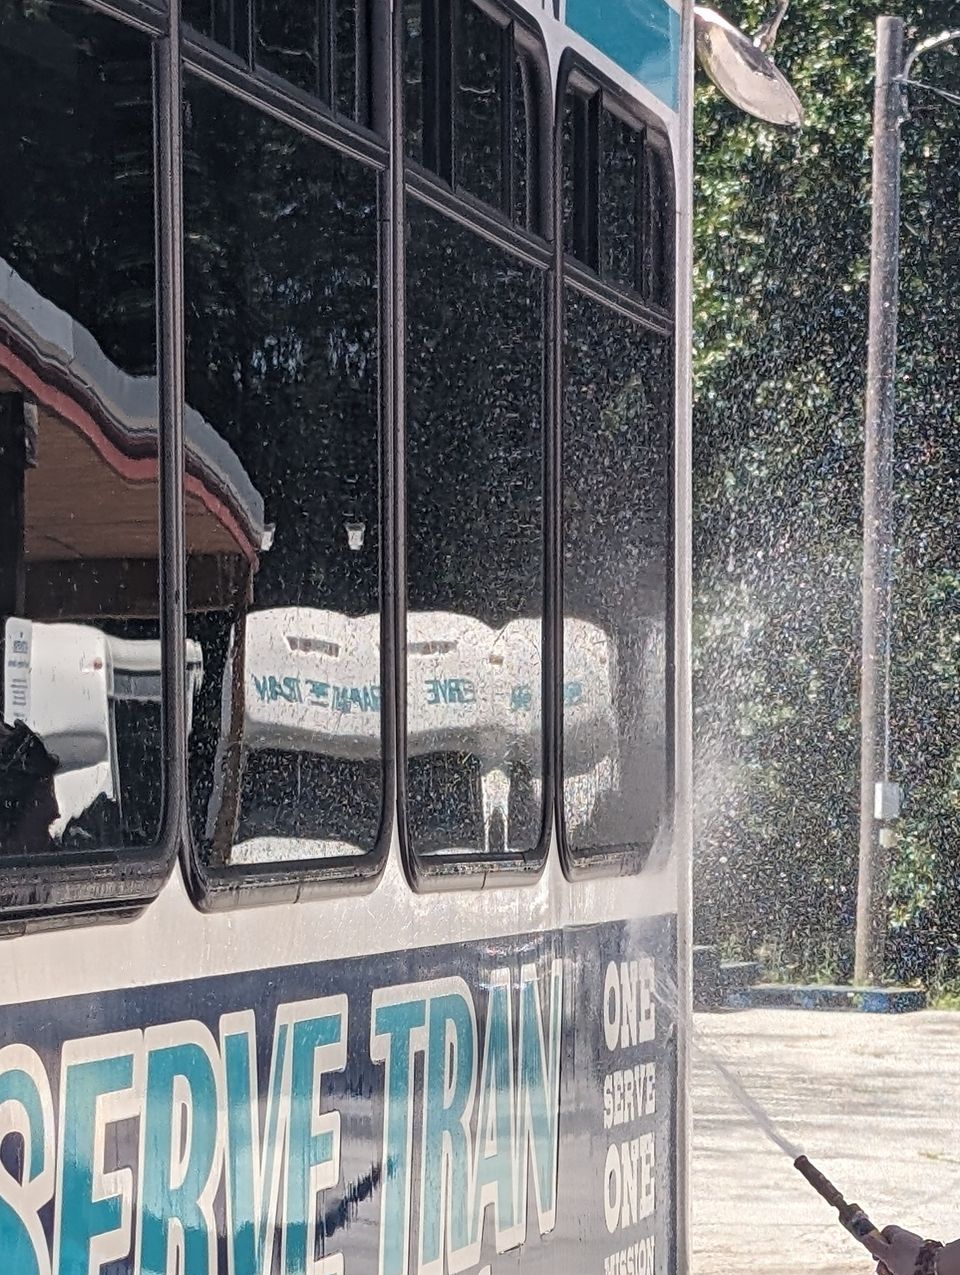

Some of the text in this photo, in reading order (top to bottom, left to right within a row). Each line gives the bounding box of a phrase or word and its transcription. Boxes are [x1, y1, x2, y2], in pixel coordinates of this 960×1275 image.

[603, 957, 656, 1051] ONE
[603, 1061, 657, 1130] SERVE
[603, 1131, 656, 1234] ONE
